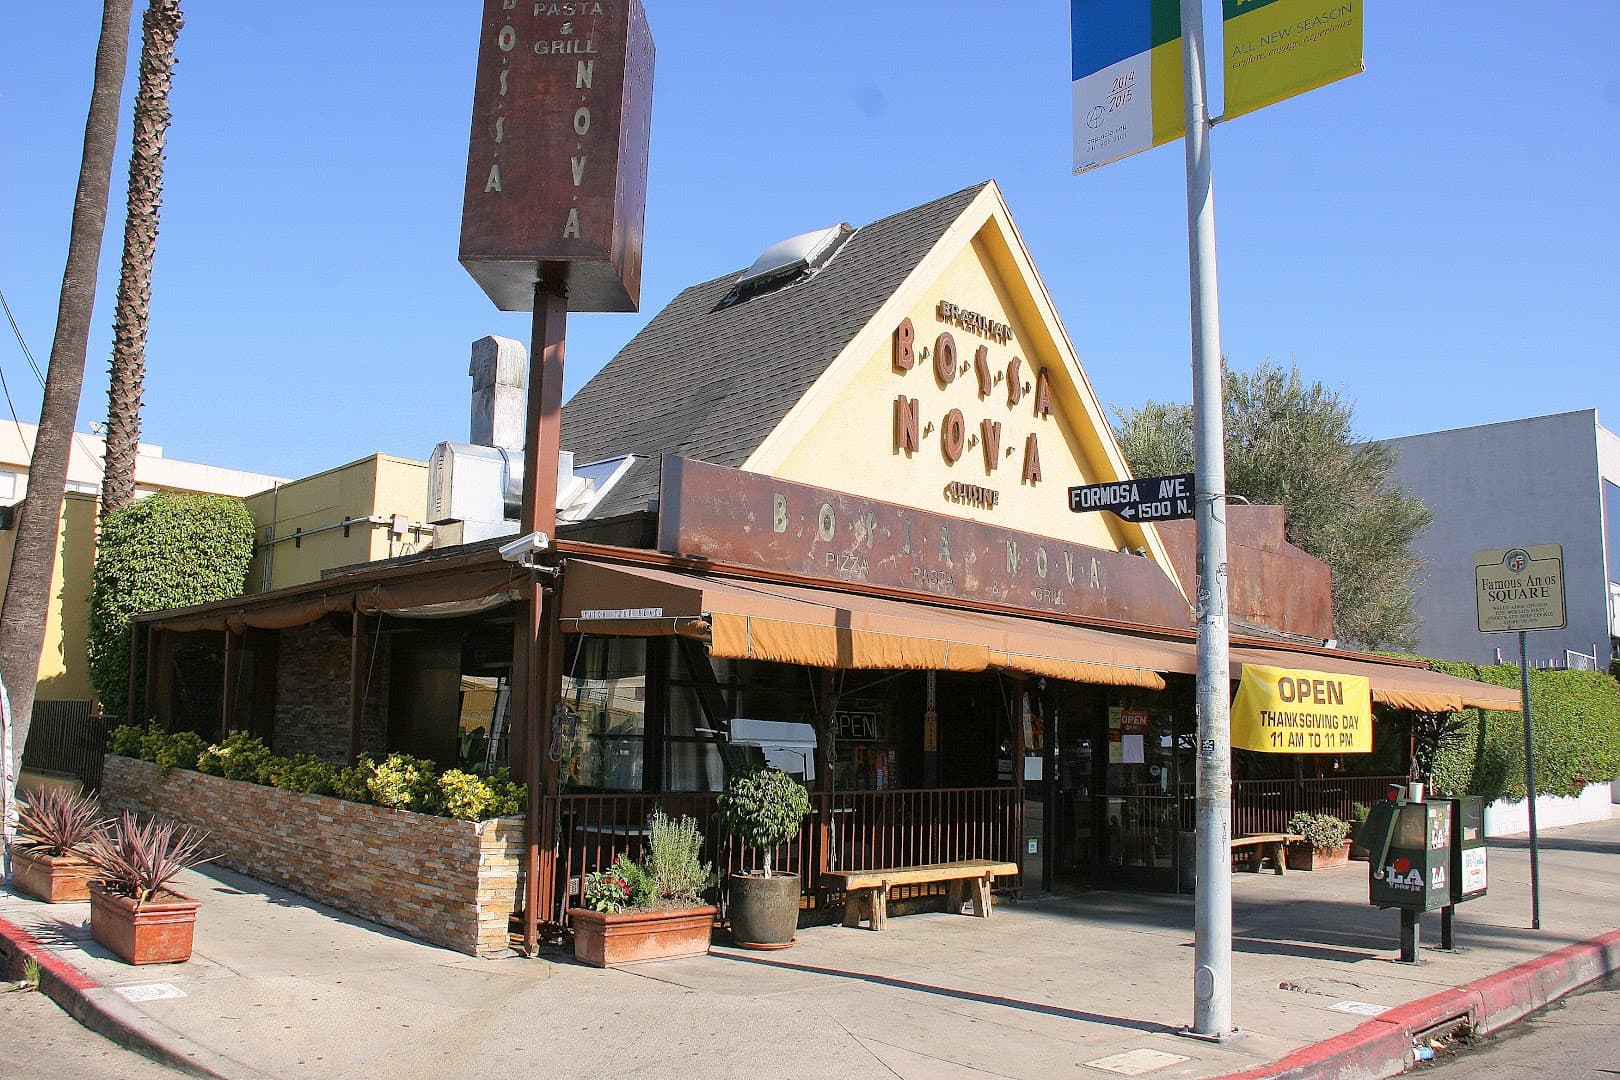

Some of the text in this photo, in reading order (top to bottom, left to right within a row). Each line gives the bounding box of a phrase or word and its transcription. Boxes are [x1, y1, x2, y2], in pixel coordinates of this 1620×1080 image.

[533, 2, 604, 16] PASTA
[1232, 2, 1352, 57] ALL NEW SEASON
[534, 40, 598, 54] GRILL
[1111, 70, 1135, 93] 2014
[1108, 89, 1133, 113] 2015
[937, 300, 1014, 342] BRAZILIAN
[1071, 478, 1190, 509] FORMOSA AVE.
[1138, 499, 1192, 519] 1500 N.
[826, 552, 870, 576] PIZZA
[1481, 578, 1521, 591] Famous
[1488, 586, 1550, 603] SQUARE
[1277, 676, 1344, 705] OPEN
[1121, 715, 1146, 725] OPEN
[1260, 710, 1359, 730] THANKSGIVING DAY
[1270, 731, 1353, 748] 11 AM TO 11 PM
[1385, 864, 1425, 887] LA
